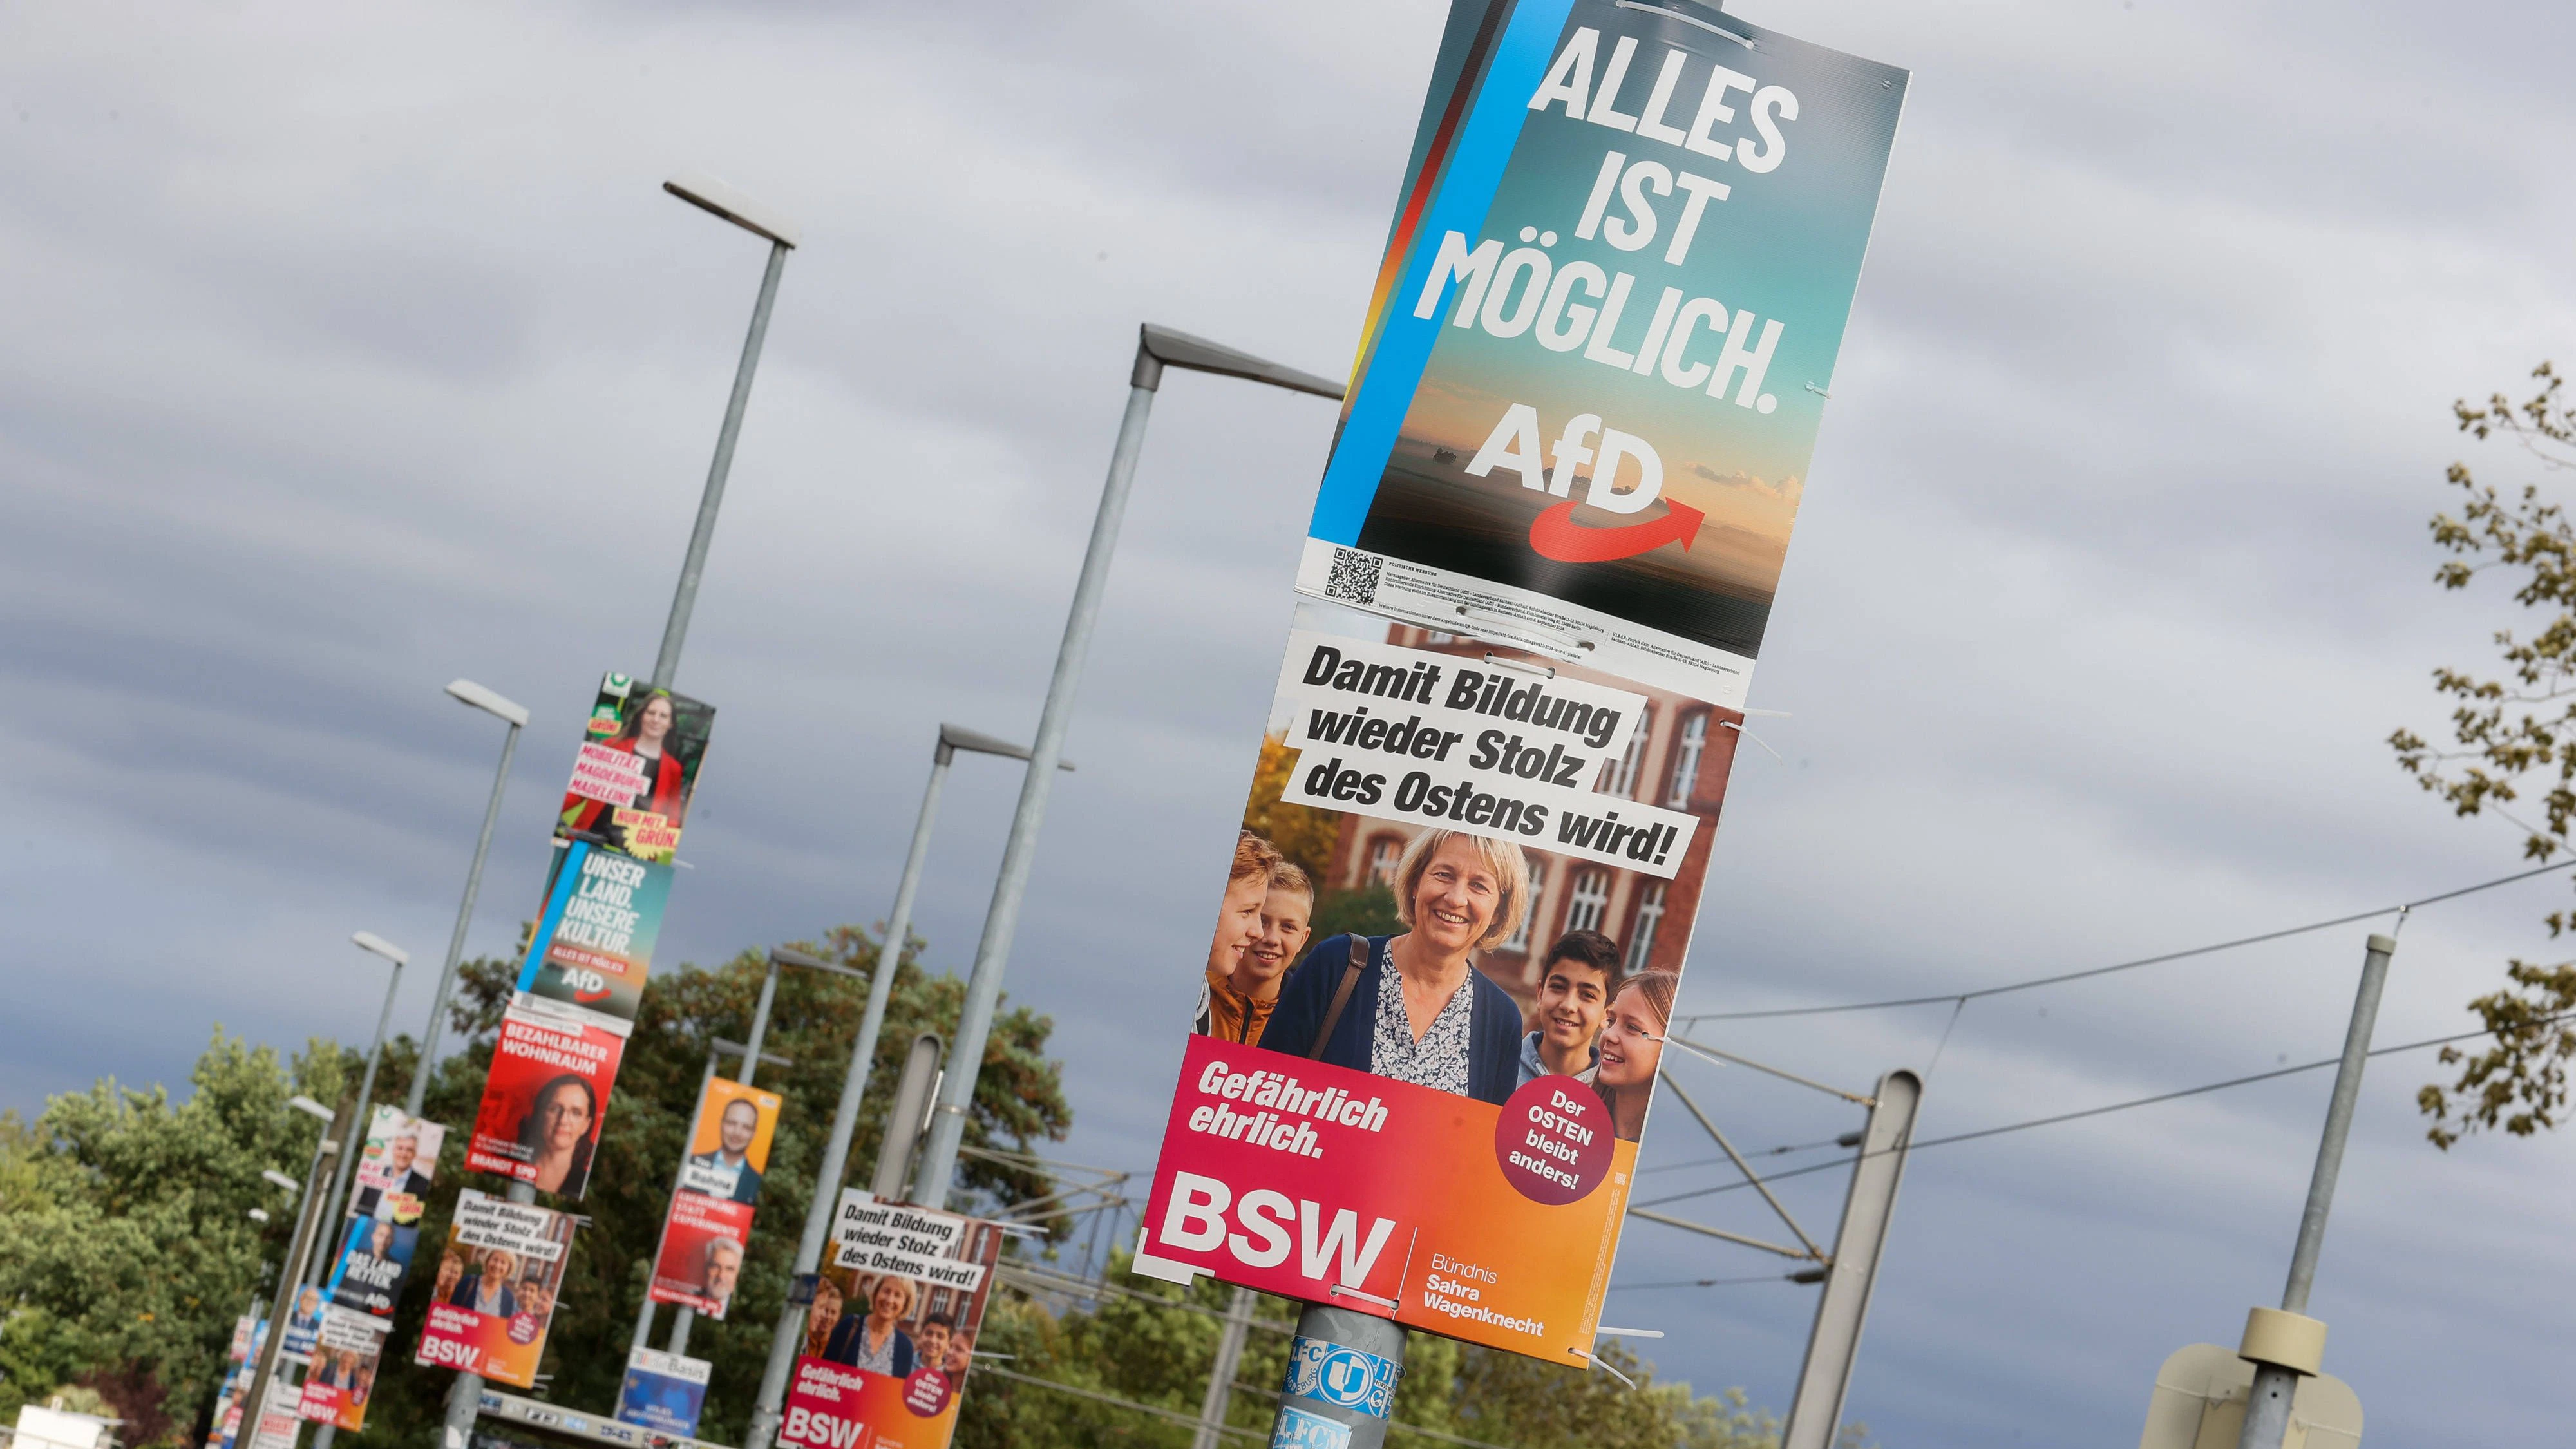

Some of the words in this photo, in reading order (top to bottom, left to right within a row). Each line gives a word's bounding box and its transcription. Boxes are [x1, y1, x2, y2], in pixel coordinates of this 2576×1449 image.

[1527, 26, 1799, 173] ALLES
[1574, 150, 1731, 266] IST
[1413, 226, 1785, 415] MÖGLICH.
[1464, 402, 1663, 514] AfD
[1388, 561, 1414, 571] POLITISCHE
[1416, 567, 1437, 576] WERBUNG
[1394, 584, 1411, 592] Werbung
[1426, 591, 1456, 603] Zusammenhang
[1437, 583, 1459, 592] Deutschland
[1650, 644, 1670, 654] Alternative
[1676, 652, 1699, 663] Deutschland
[1302, 645, 1441, 705] Damit
[1444, 675, 1621, 748] Bildung
[1307, 708, 1464, 762] wieder
[1468, 730, 1586, 788] Stolz
[615, 810, 639, 825] NUR
[1304, 758, 1387, 802] des
[1394, 772, 1549, 836] Ostens
[1557, 811, 1678, 865] wird!
[583, 853, 645, 888] UNSER
[579, 876, 632, 909] LAND.
[566, 895, 639, 934] UNSERE
[556, 917, 630, 955] KULTUR.
[561, 968, 603, 992] AfD
[502, 1039, 597, 1076] WOHNRAUM
[505, 1023, 607, 1062] BEZAHLBARER
[1198, 1061, 1390, 1132] Gefährlich
[1551, 1090, 1586, 1117] Der
[1189, 1104, 1324, 1159] ehrlich.
[1528, 1106, 1593, 1146] OSTEN
[1526, 1128, 1578, 1165] bleibt
[1509, 1150, 1580, 1190] anders!
[844, 1204, 889, 1222] Damit
[891, 1213, 952, 1240] Bildung
[1159, 1171, 1396, 1289] BSW
[844, 1227, 895, 1247] wieder
[897, 1236, 940, 1256] Stolz
[842, 1248, 867, 1265] des
[871, 1253, 923, 1275] Ostens
[928, 1265, 976, 1285] wird!
[1431, 1253, 1497, 1284] Bündnis
[1426, 1274, 1480, 1302] Sahra
[1423, 1291, 1544, 1337] Wagenknecht
[421, 1335, 480, 1367] BSW
[801, 1363, 863, 1391] Gefährlich
[785, 1406, 864, 1449] BSW
